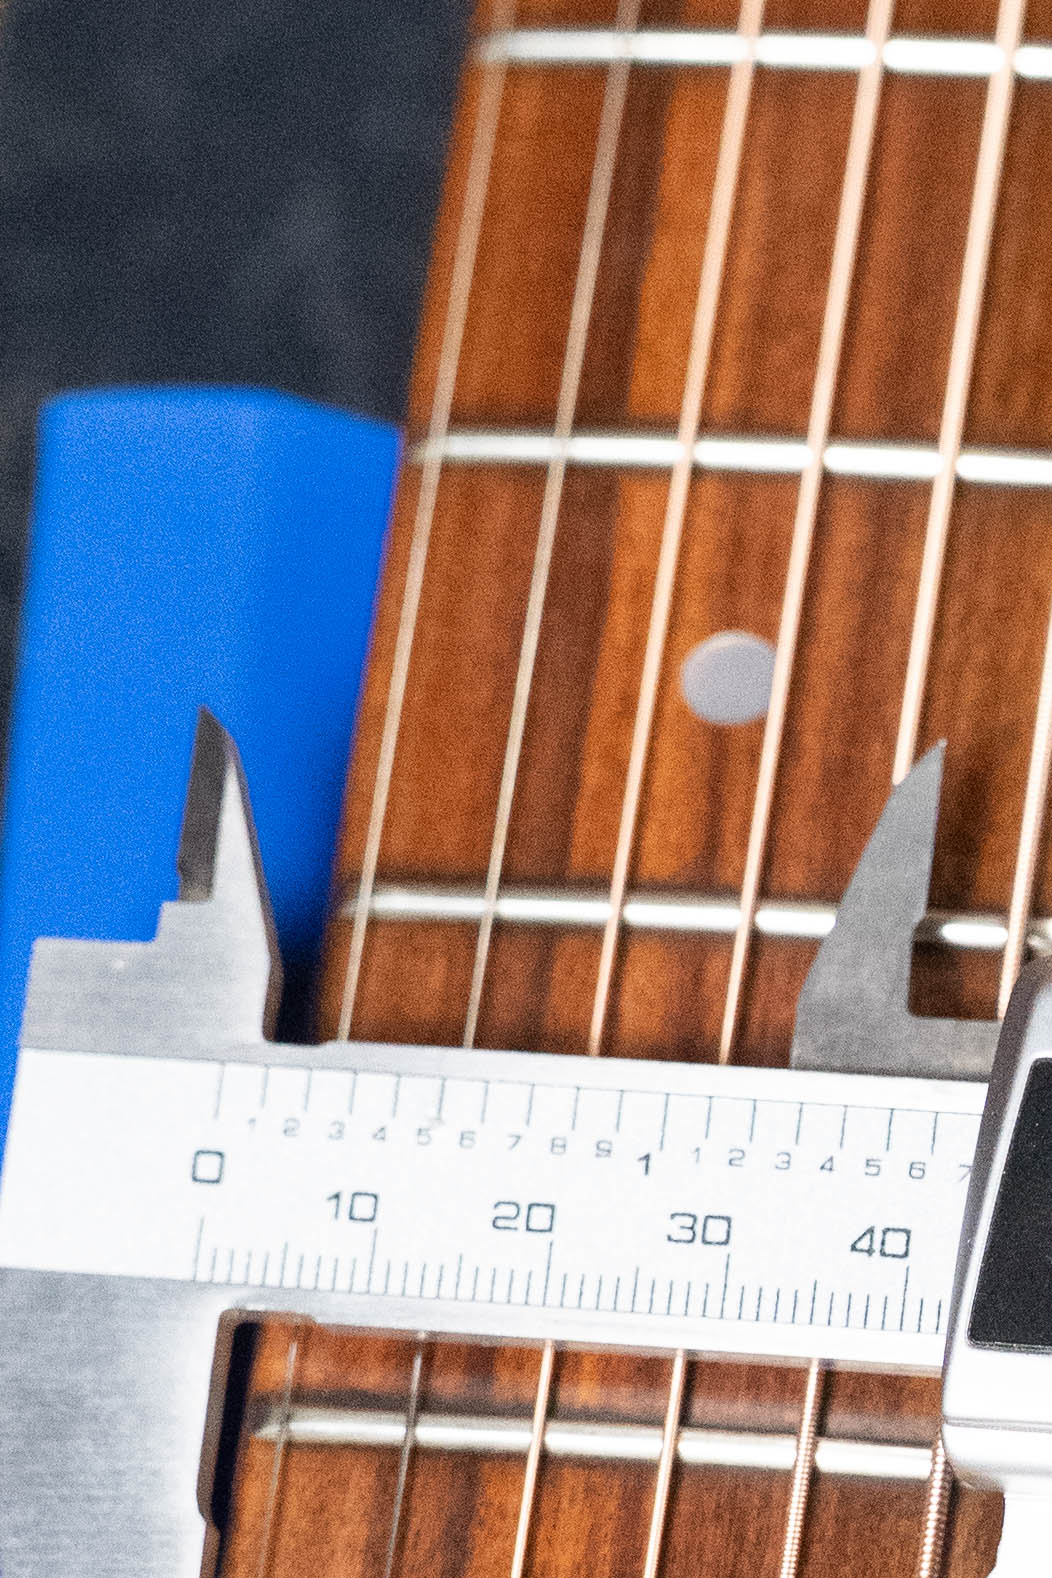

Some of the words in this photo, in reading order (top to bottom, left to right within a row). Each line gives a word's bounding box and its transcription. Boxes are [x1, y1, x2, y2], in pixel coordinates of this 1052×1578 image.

[637, 1153, 652, 1176] 1
[728, 1148, 746, 1168] 2
[775, 1151, 792, 1170] 3
[819, 1155, 836, 1173] 4
[864, 1158, 882, 1177] 5
[908, 1161, 926, 1180] 6
[191, 1149, 225, 1184] 0
[325, 1191, 379, 1222] 10
[492, 1201, 555, 1233] 20
[667, 1212, 732, 1246] 30
[850, 1226, 912, 1258] 40
